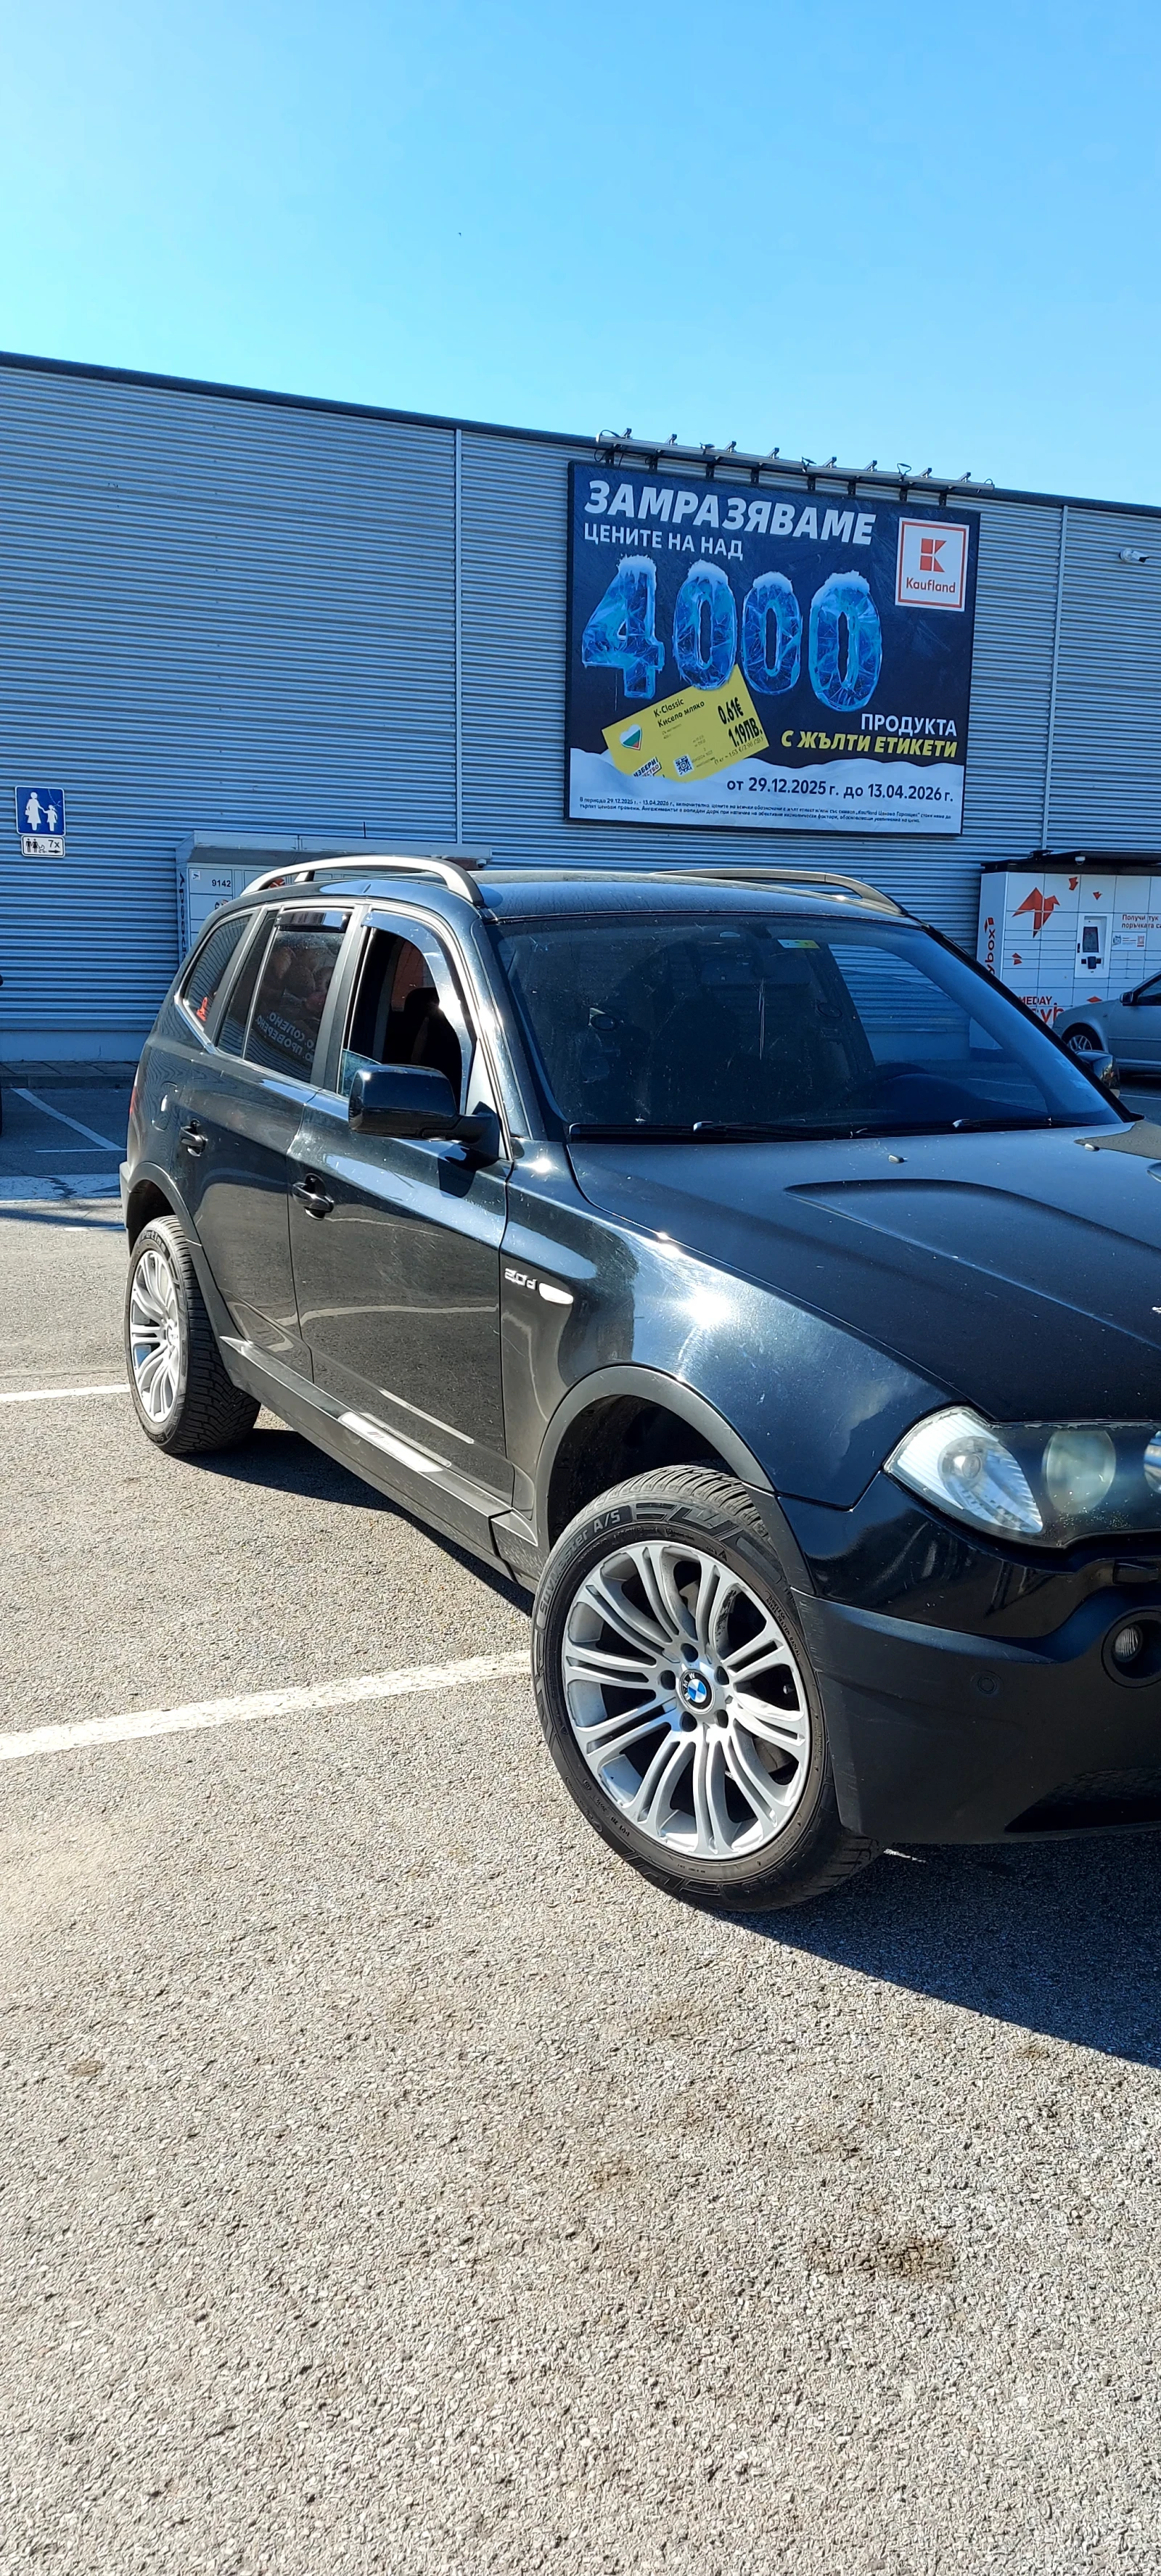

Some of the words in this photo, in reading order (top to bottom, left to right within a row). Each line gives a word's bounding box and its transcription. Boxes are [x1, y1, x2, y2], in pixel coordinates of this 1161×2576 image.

[584, 480, 877, 546] ЗАМРАЗЯВАМЕ
[584, 522, 662, 549] ЦЕНИТЕ
[668, 531, 695, 552] НА
[701, 536, 743, 561] НАД
[906, 576, 956, 594] Kaufland
[582, 554, 882, 712] 4000
[657, 710, 683, 728] Кисело
[684, 700, 705, 716] мляко
[717, 696, 744, 725] 0.61€
[861, 713, 957, 737] ПРОДУКТА
[781, 730, 795, 747] С
[797, 731, 871, 752] ЖЪЛТИ
[874, 736, 958, 758] ЕТИКЕТИ
[726, 780, 744, 791] от
[748, 776, 826, 795] 29.12.2025
[829, 785, 839, 796] г.
[843, 787, 863, 799] до
[868, 783, 942, 800] 13.04.2026
[944, 791, 953, 802] г.
[1017, 996, 1053, 1005] MEDAY
[593, 1509, 621, 1533] A/S
[682, 1672, 697, 1701] BMW
